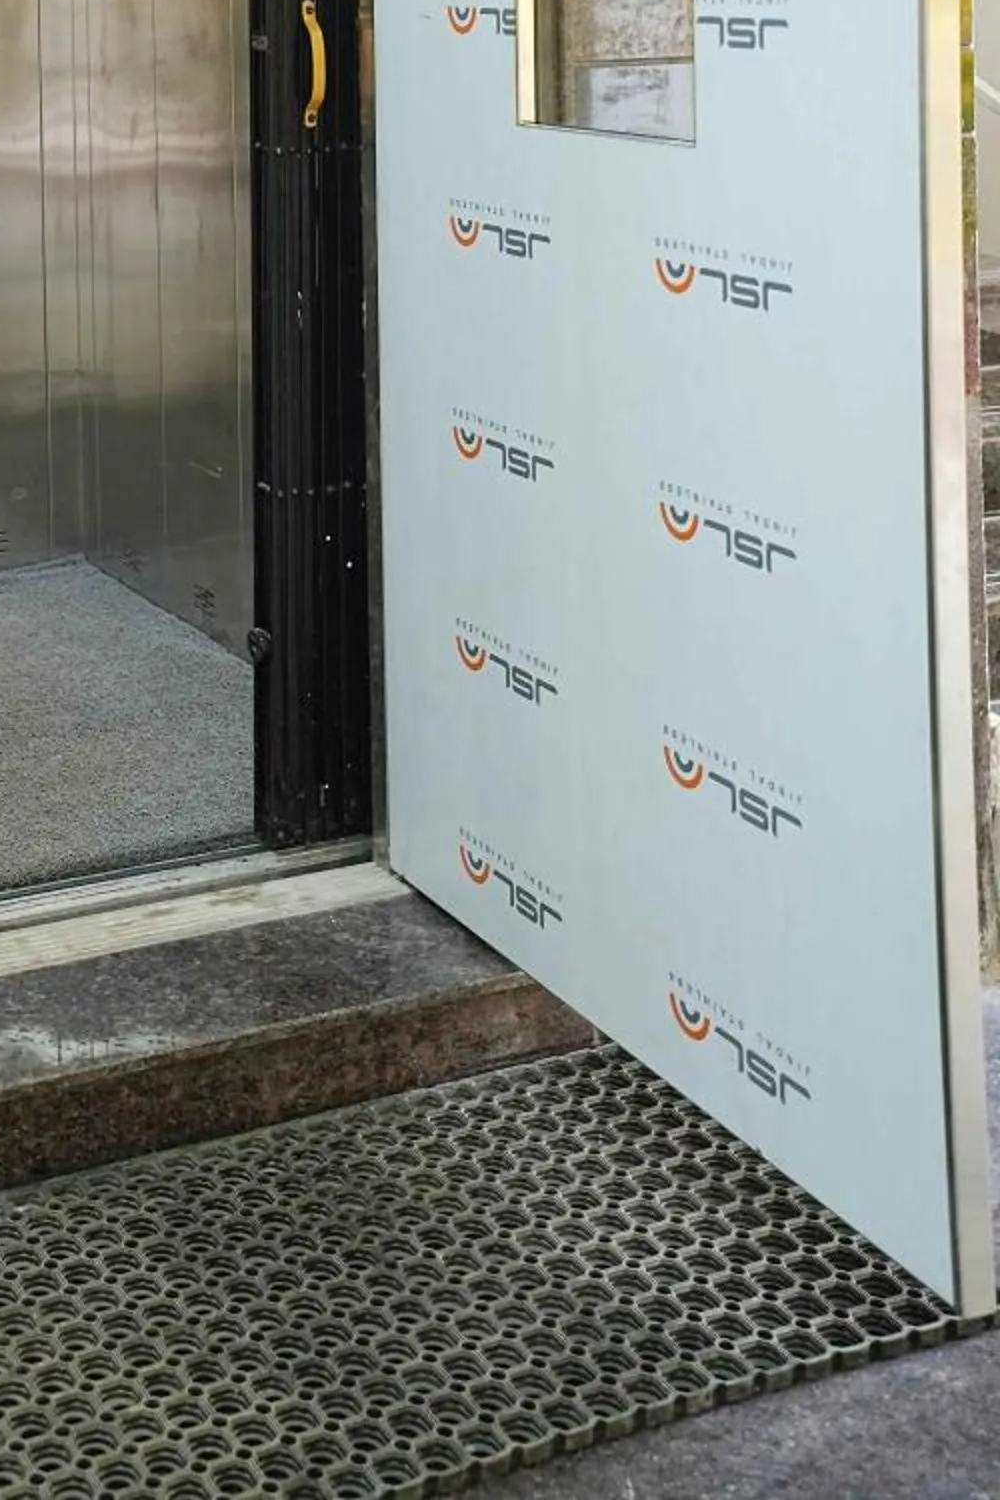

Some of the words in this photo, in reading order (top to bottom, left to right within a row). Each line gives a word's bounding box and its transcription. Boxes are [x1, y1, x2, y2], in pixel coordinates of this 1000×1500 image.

[480, 8, 516, 36] SL
[697, 16, 788, 50] JSL
[483, 224, 551, 260] JSL
[700, 268, 792, 312] JSL
[486, 438, 554, 482] JSL
[704, 520, 796, 573] JSL
[489, 654, 558, 706] JSL
[708, 772, 803, 837] JSL
[494, 870, 562, 930] JSL
[714, 1027, 811, 1105] JSL
